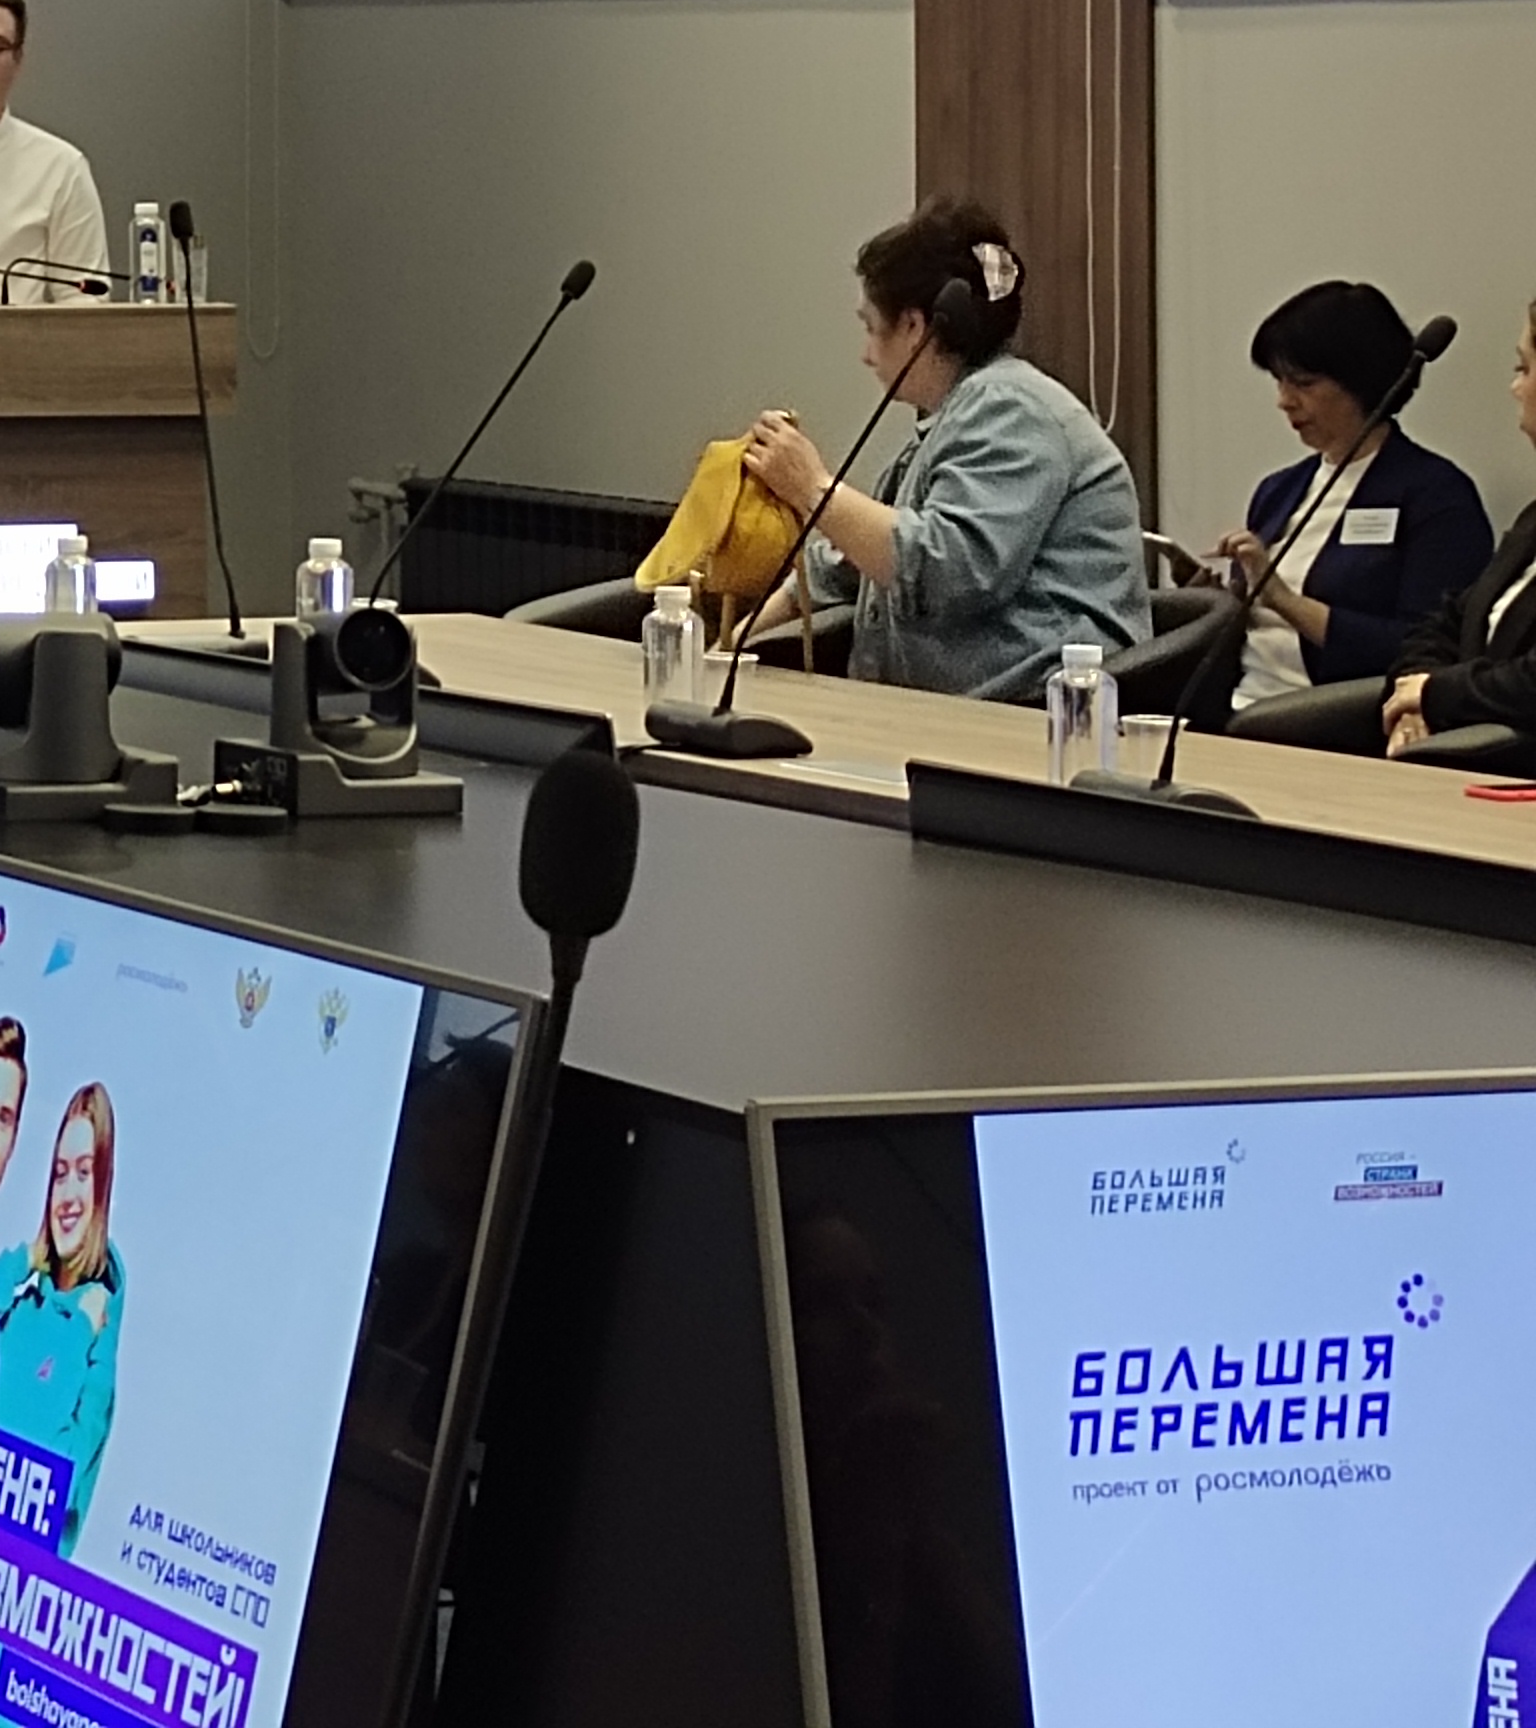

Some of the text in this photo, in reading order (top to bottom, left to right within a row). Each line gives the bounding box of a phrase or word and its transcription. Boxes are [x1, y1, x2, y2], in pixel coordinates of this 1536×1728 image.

[1090, 1190, 1225, 1215] ПЕРЕМЕНА
[1091, 1166, 1226, 1192] БОЛЬШАЯ
[1072, 1334, 1395, 1397] БОЛЬШАЯ
[1068, 1391, 1390, 1457] ПЕРЕМЕНА
[1072, 1458, 1392, 1505] проект от росмолодёжь
[129, 1504, 277, 1587] для школьников
[137, 1546, 227, 1609] студентов
[230, 1583, 270, 1629] СПО
